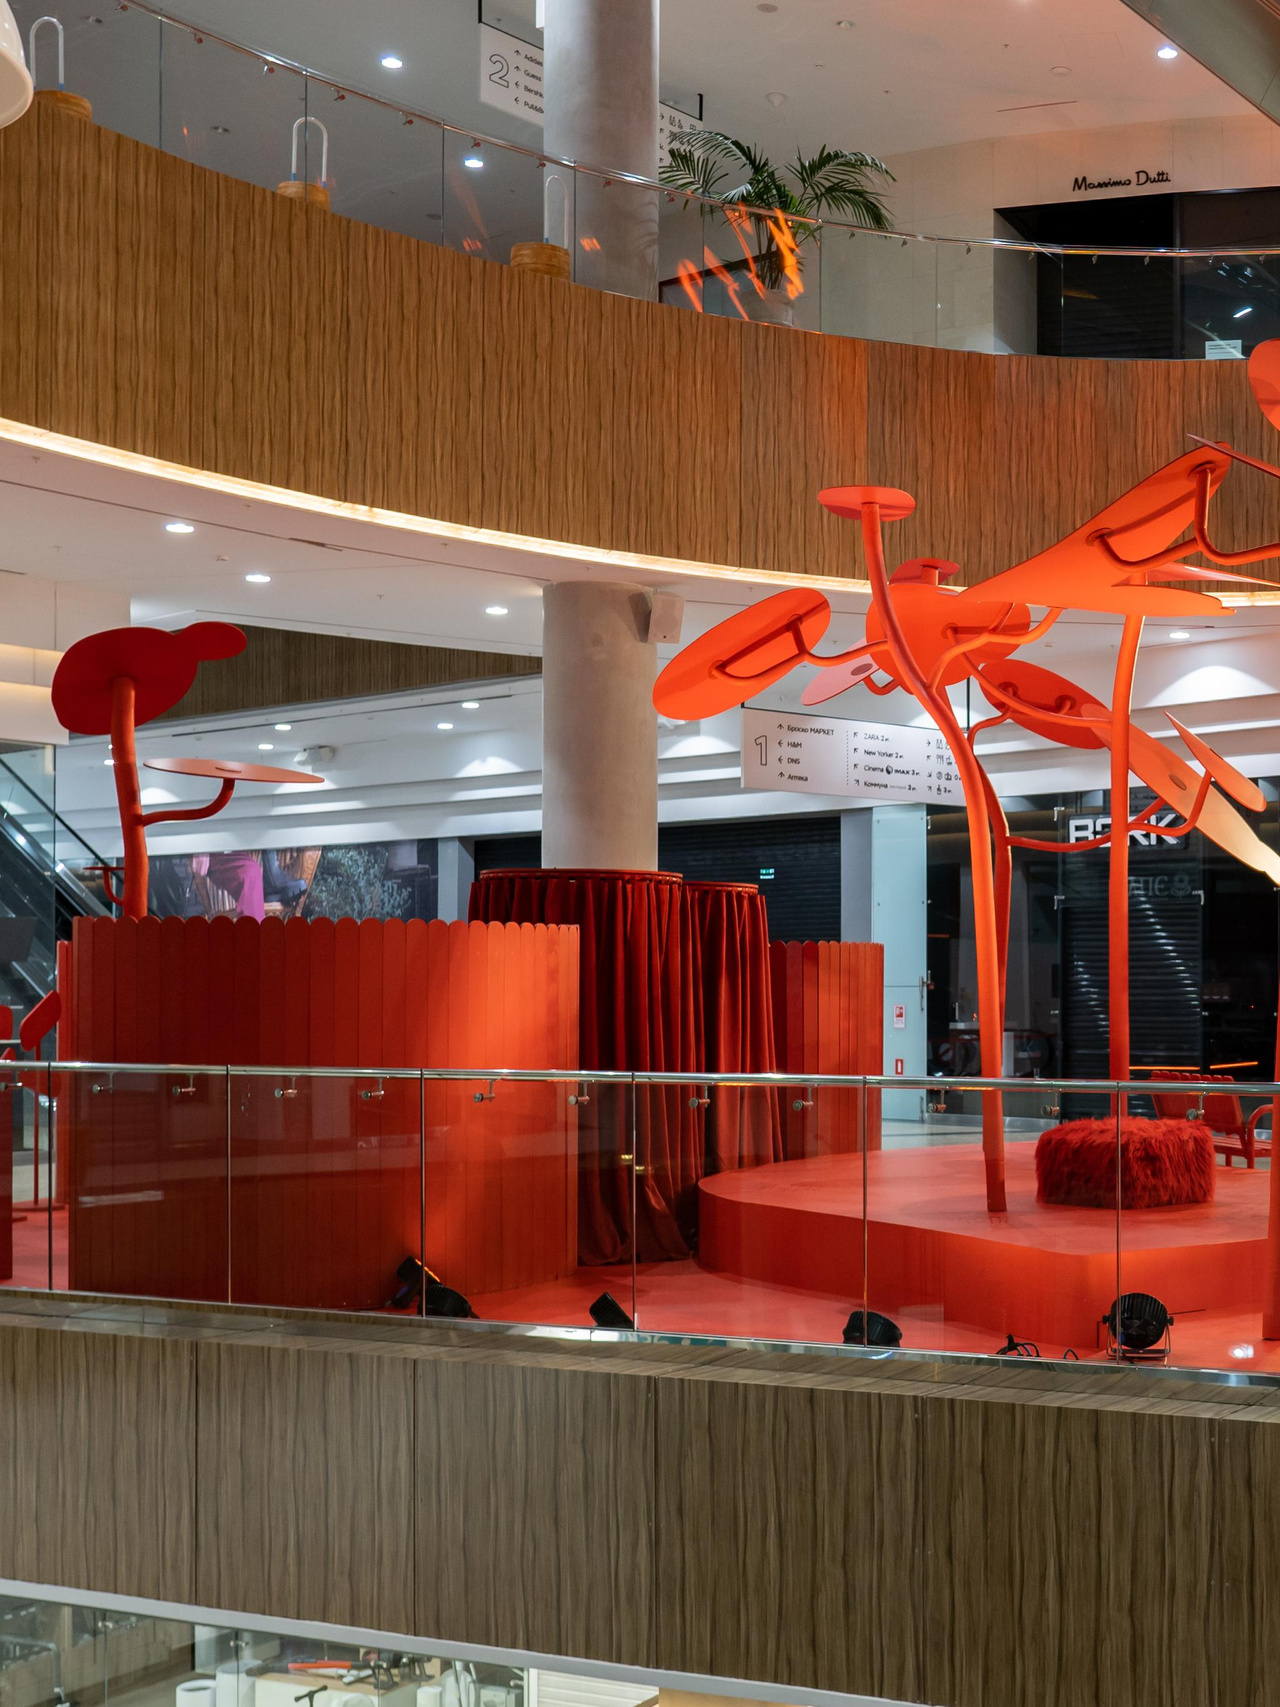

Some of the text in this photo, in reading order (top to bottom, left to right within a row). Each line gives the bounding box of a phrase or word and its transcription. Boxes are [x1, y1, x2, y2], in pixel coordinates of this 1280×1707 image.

[489, 53, 509, 89] 2
[524, 85, 544, 99] Bershk
[524, 101, 544, 114] Pull&B
[1072, 170, 1172, 192] Massimo Dutti
[787, 724, 834, 736] Броско МАРКЕТ
[864, 733, 879, 741] ZARA
[754, 735, 767, 766] 1
[787, 741, 802, 749] H&M
[864, 765, 884, 773] Cinema
[787, 773, 808, 782] Аптека
[864, 780, 888, 789] Коммуна
